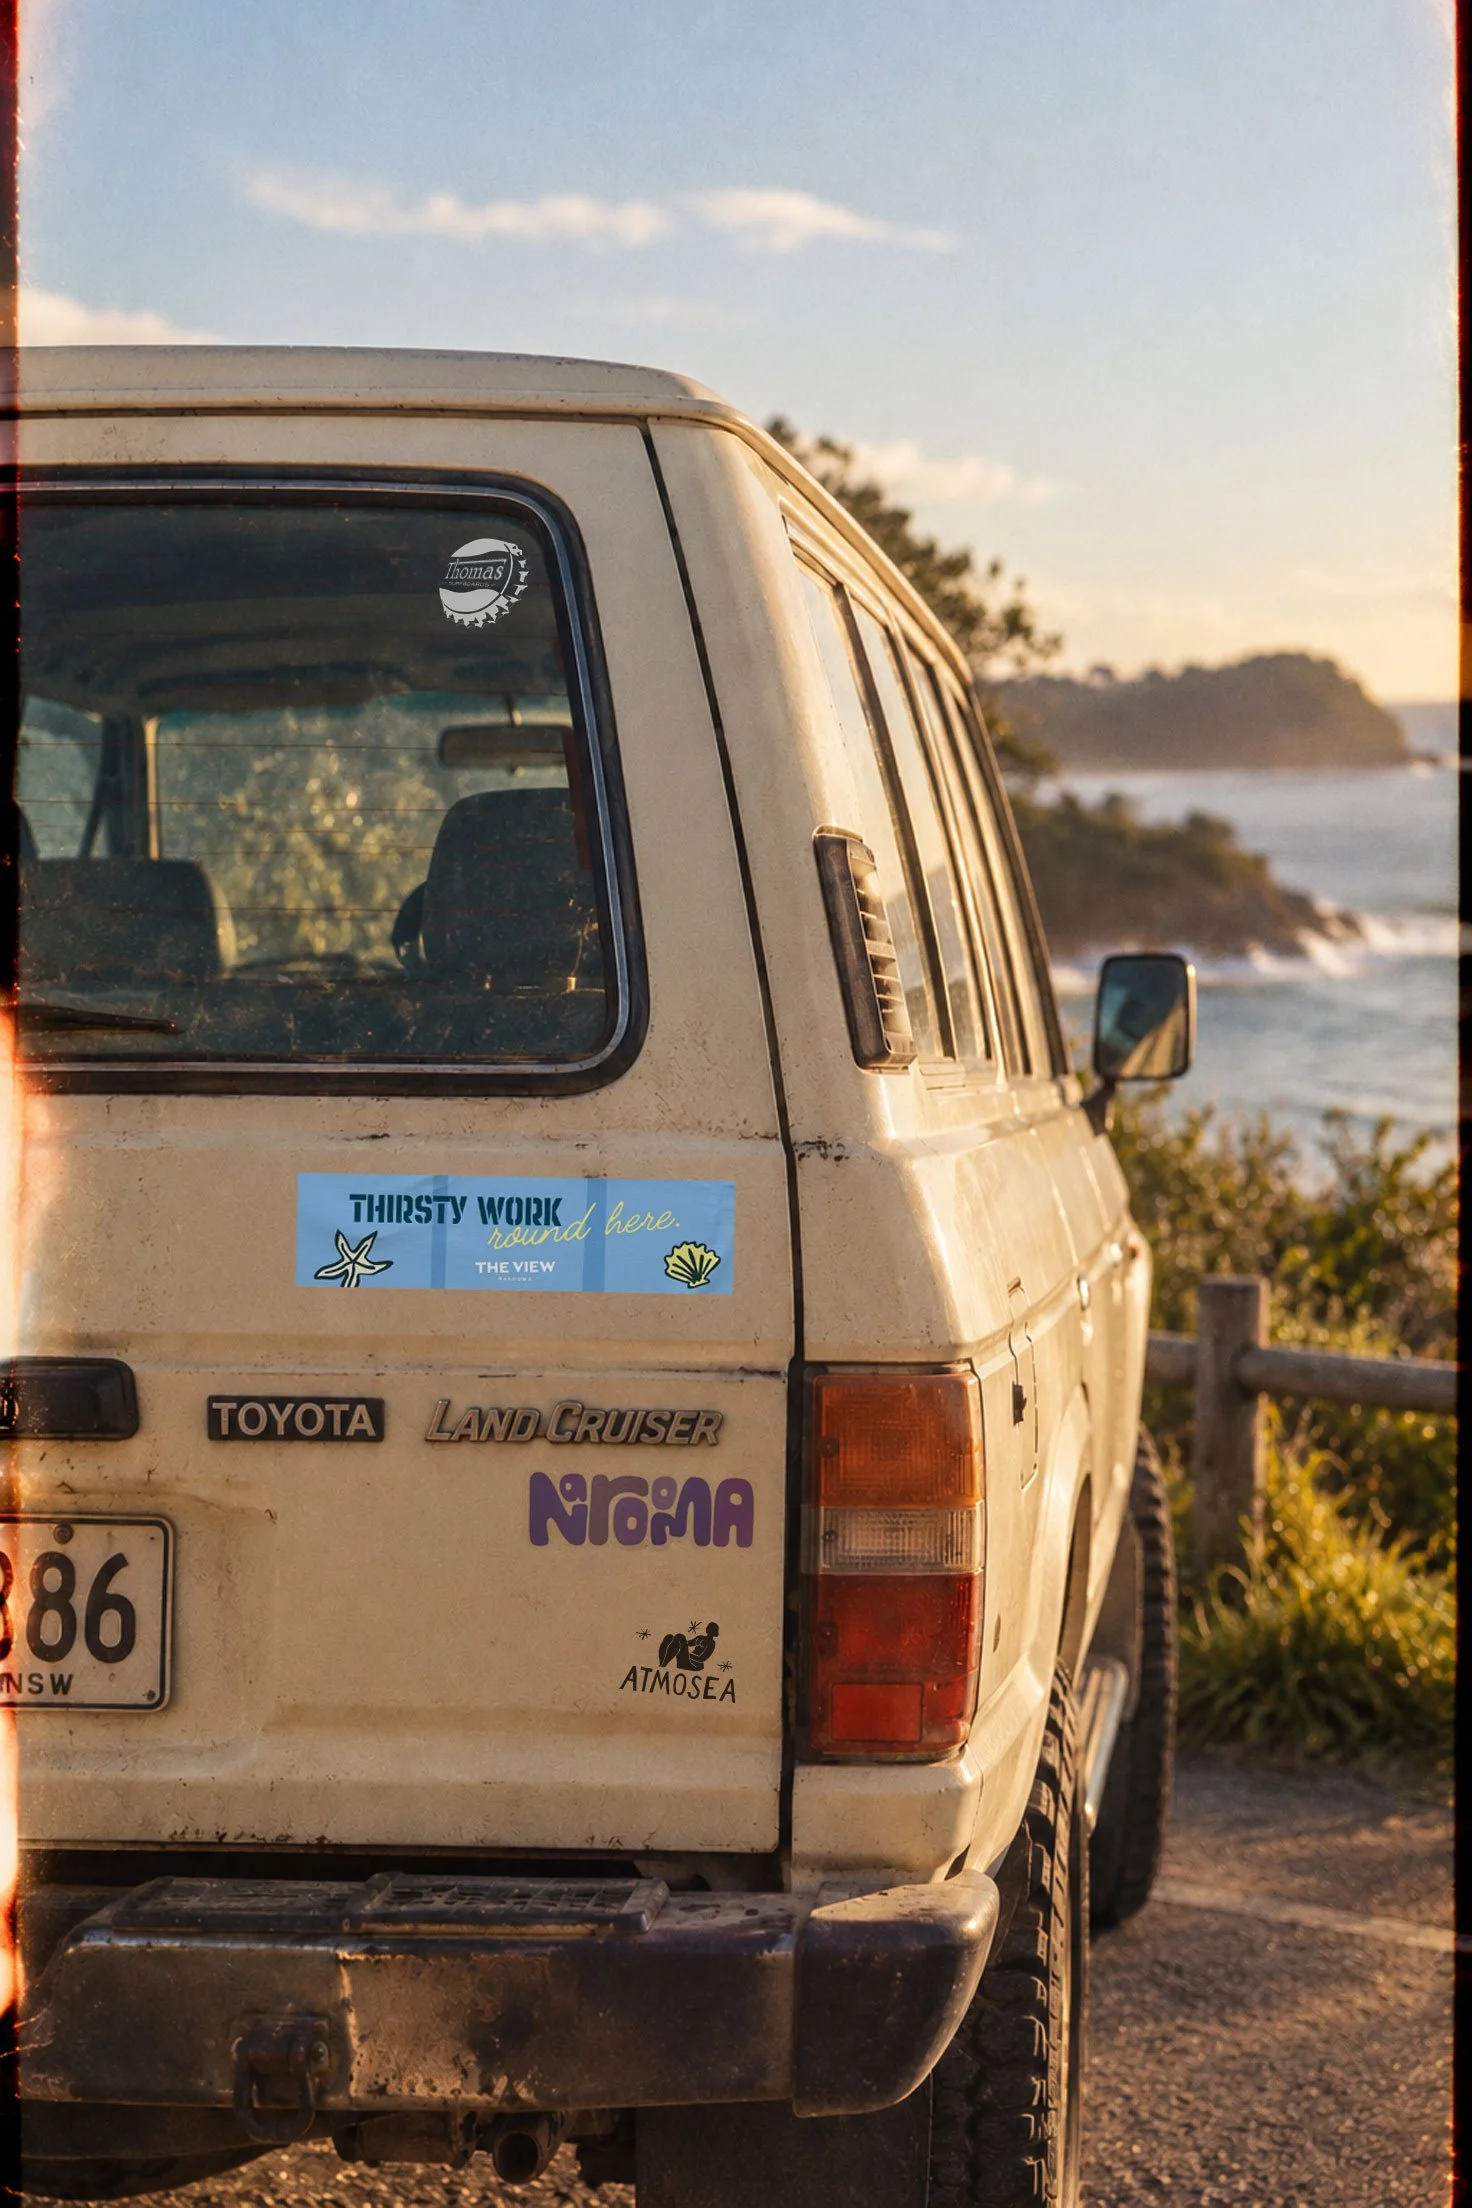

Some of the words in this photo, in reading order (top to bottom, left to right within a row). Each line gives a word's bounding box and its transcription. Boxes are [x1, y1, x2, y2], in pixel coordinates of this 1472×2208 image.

[445, 558, 507, 581] Thomas
[349, 1193, 468, 1225] THIRSTY
[477, 1196, 563, 1227] WORK
[487, 1201, 597, 1250] round
[604, 1199, 680, 1236] here.
[475, 1261, 509, 1274] THE
[512, 1260, 556, 1273] VIEW
[212, 1402, 377, 1437] TOYOTA
[6, 1672, 74, 1695] NSW
[619, 1665, 737, 1704] ATMOSEA
